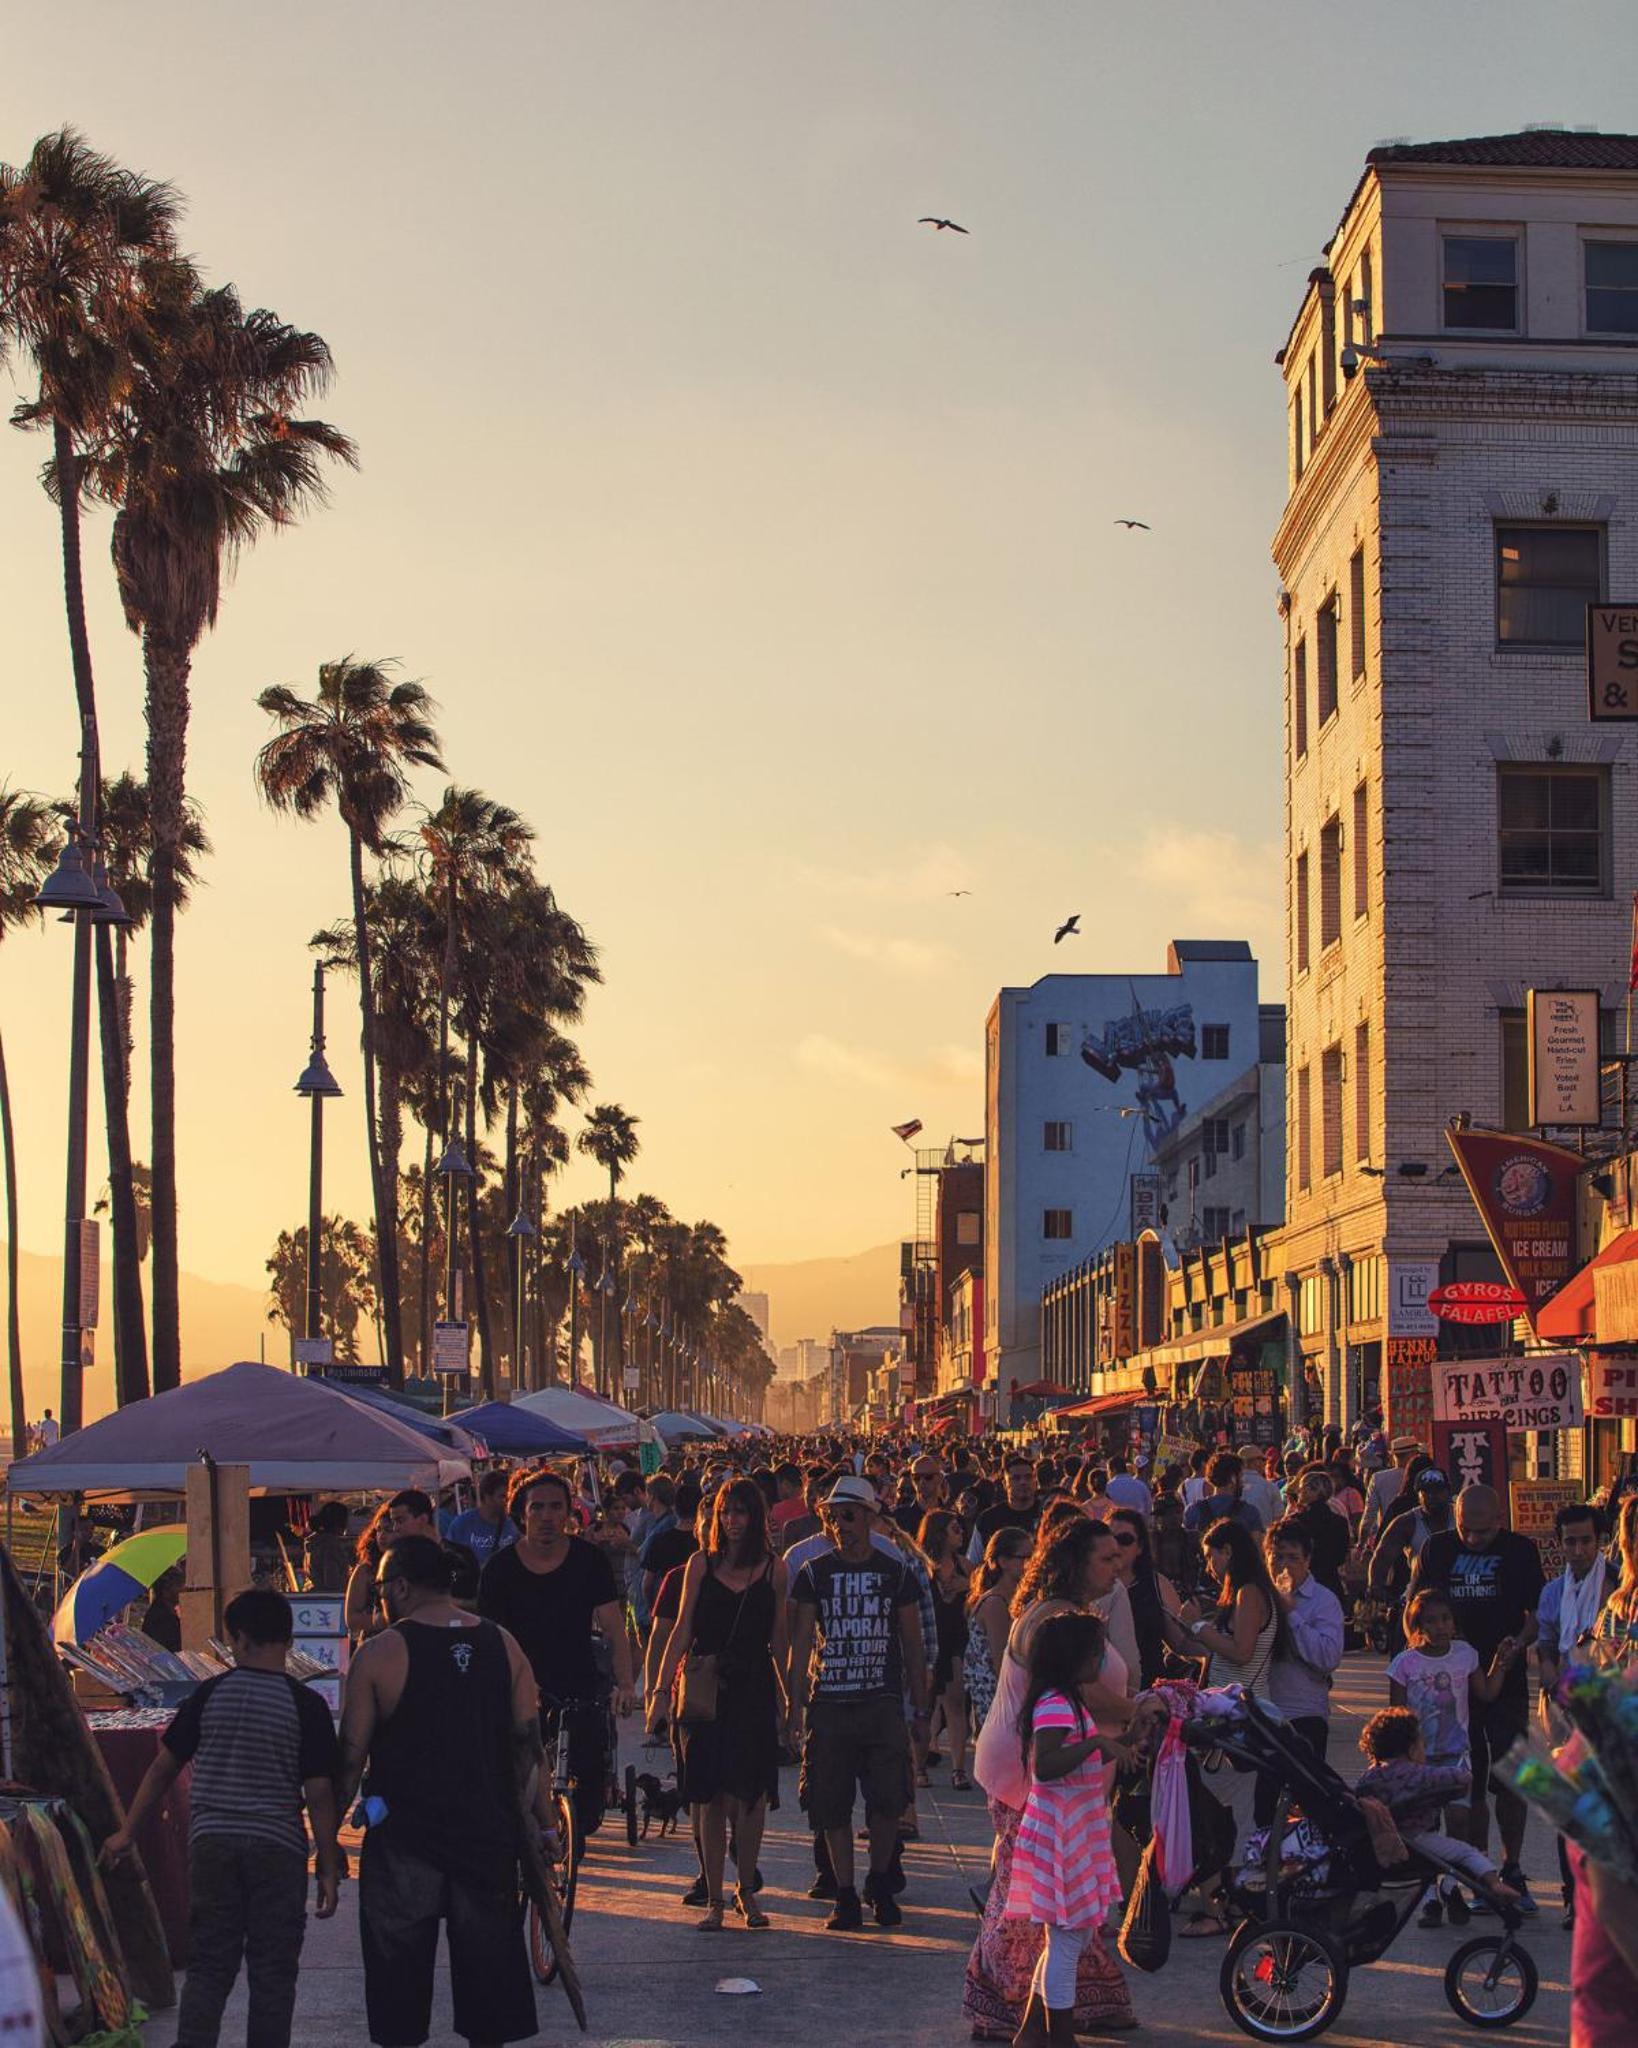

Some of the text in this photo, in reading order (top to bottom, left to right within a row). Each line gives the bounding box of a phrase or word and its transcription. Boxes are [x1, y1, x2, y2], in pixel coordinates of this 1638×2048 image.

[1603, 682, 1628, 708] &
[1554, 1026, 1578, 1034] Fresh
[1547, 1036, 1585, 1044] Gourmet
[1547, 1046, 1586, 1055] Hand-cut
[1555, 1056, 1578, 1064] Fries
[1554, 1074, 1579, 1082] Voted
[1512, 1240, 1568, 1257] ICE CREAM
[1443, 1283, 1513, 1301] GYROS
[1119, 1252, 1132, 1353] PIZZA
[1440, 1303, 1516, 1322] FALAFEL
[1388, 1340, 1438, 1354] HENNA
[1603, 1368, 1637, 1388] PI
[1448, 1366, 1568, 1408] TATTOO
[1458, 1406, 1562, 1428] PIERCINGS
[1450, 1553, 1503, 1574] NIKE
[830, 1572, 874, 1595] THE
[1464, 1574, 1481, 1585] OR
[1450, 1585, 1497, 1598] NOTHING
[820, 1596, 892, 1617] DRUMS
[850, 1639, 888, 1655] TOUR
